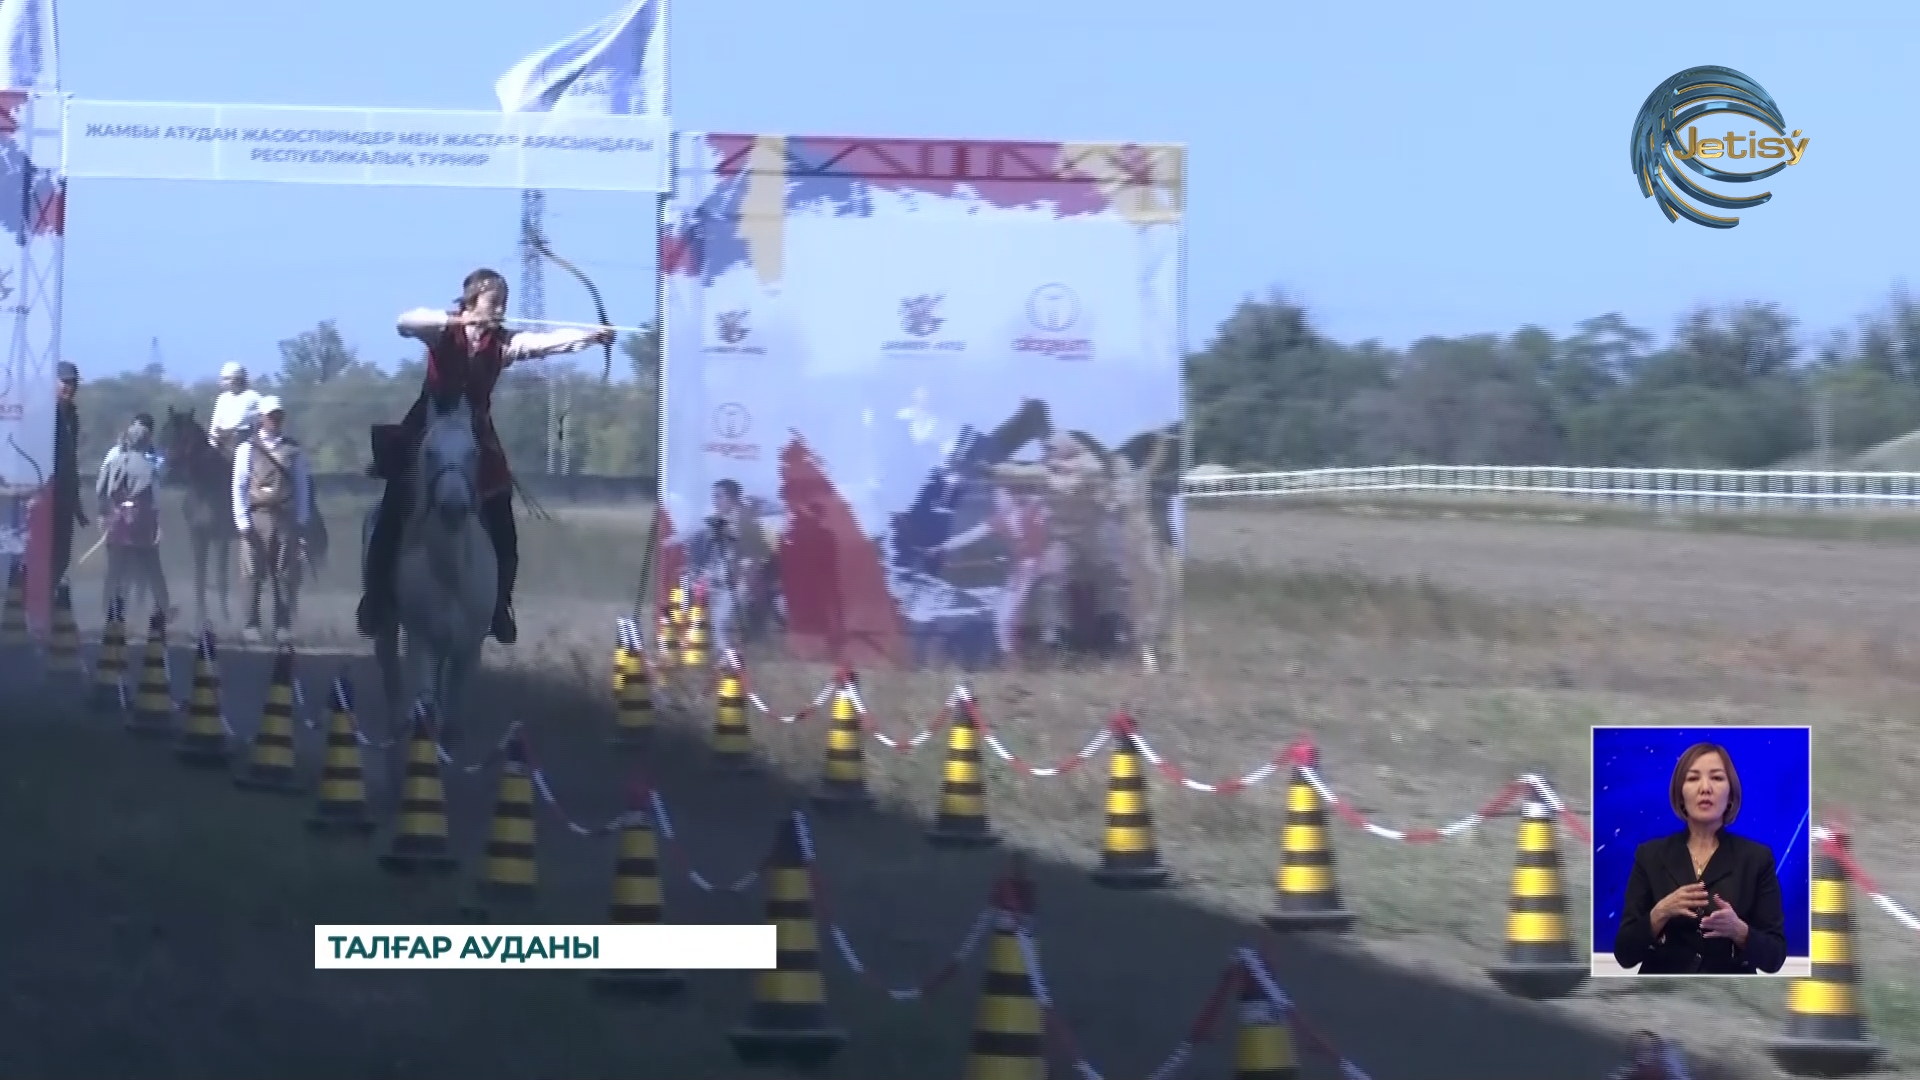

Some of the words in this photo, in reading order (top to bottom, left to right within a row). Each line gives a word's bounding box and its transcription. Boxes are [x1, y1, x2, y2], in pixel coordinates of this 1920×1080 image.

[85, 123, 160, 139] ЖАМБЫ
[164, 125, 238, 142] АТУДАН
[399, 132, 440, 146] МЕН
[250, 148, 415, 167] РЕСПУБЛИКАЛЫҚ
[418, 152, 490, 167] ТУРНИР
